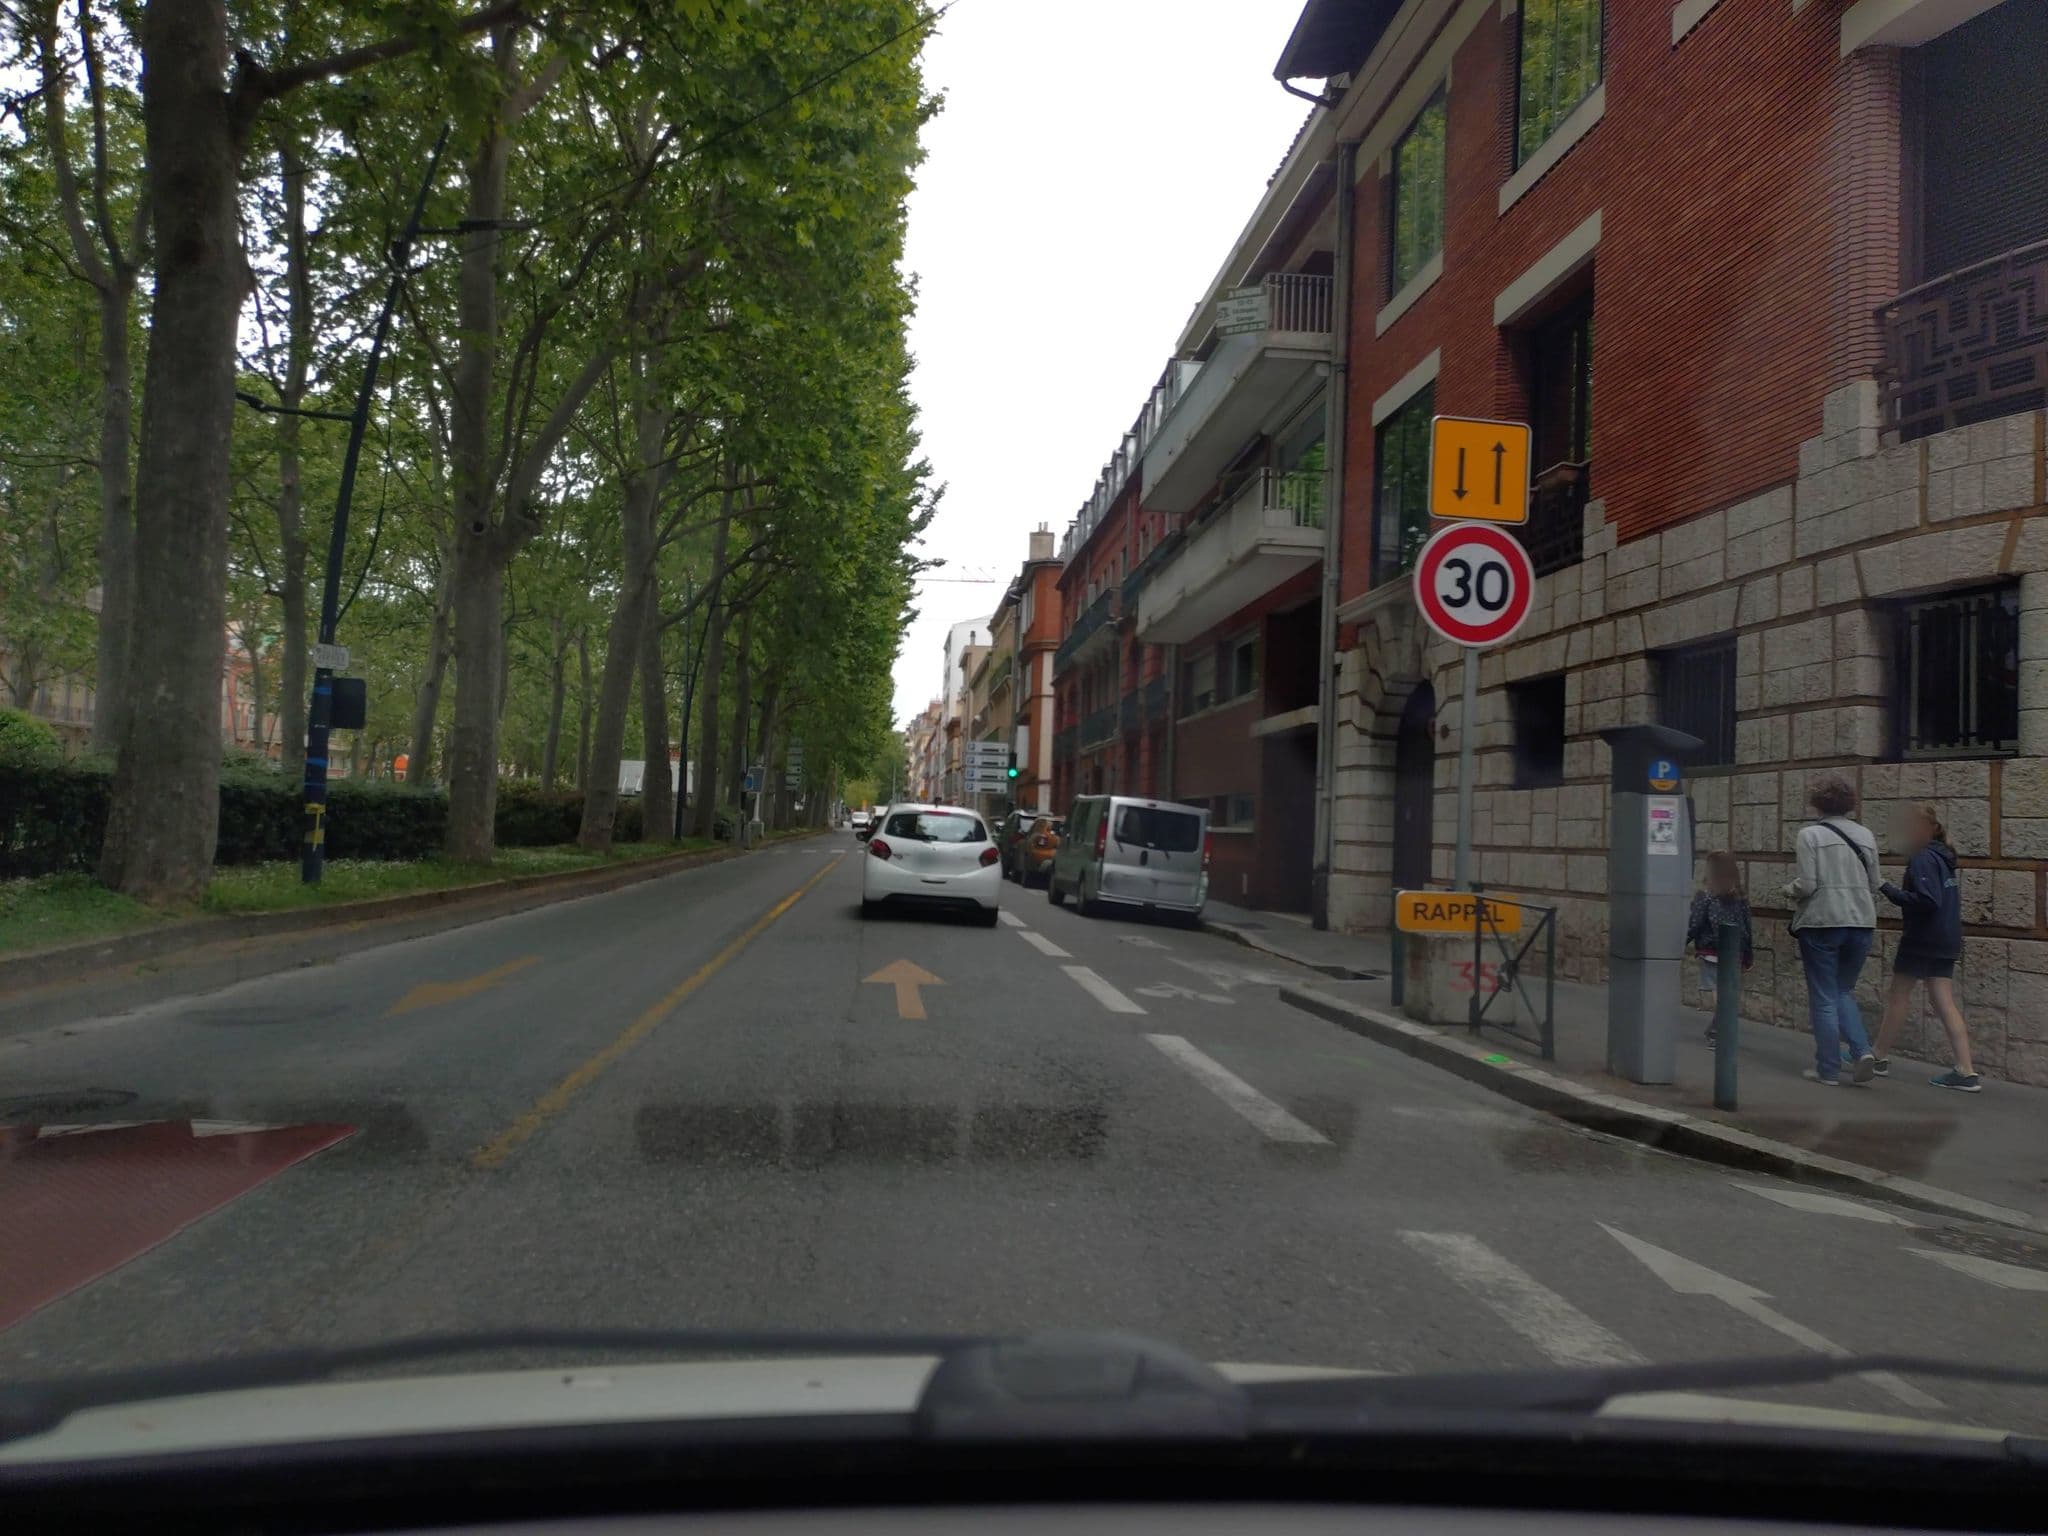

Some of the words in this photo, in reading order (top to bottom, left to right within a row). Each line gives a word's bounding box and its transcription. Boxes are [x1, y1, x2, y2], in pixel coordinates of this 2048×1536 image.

[1442, 558, 1510, 611] 30
[1658, 760, 1671, 778] P
[1413, 902, 1505, 922] RAPPEL
